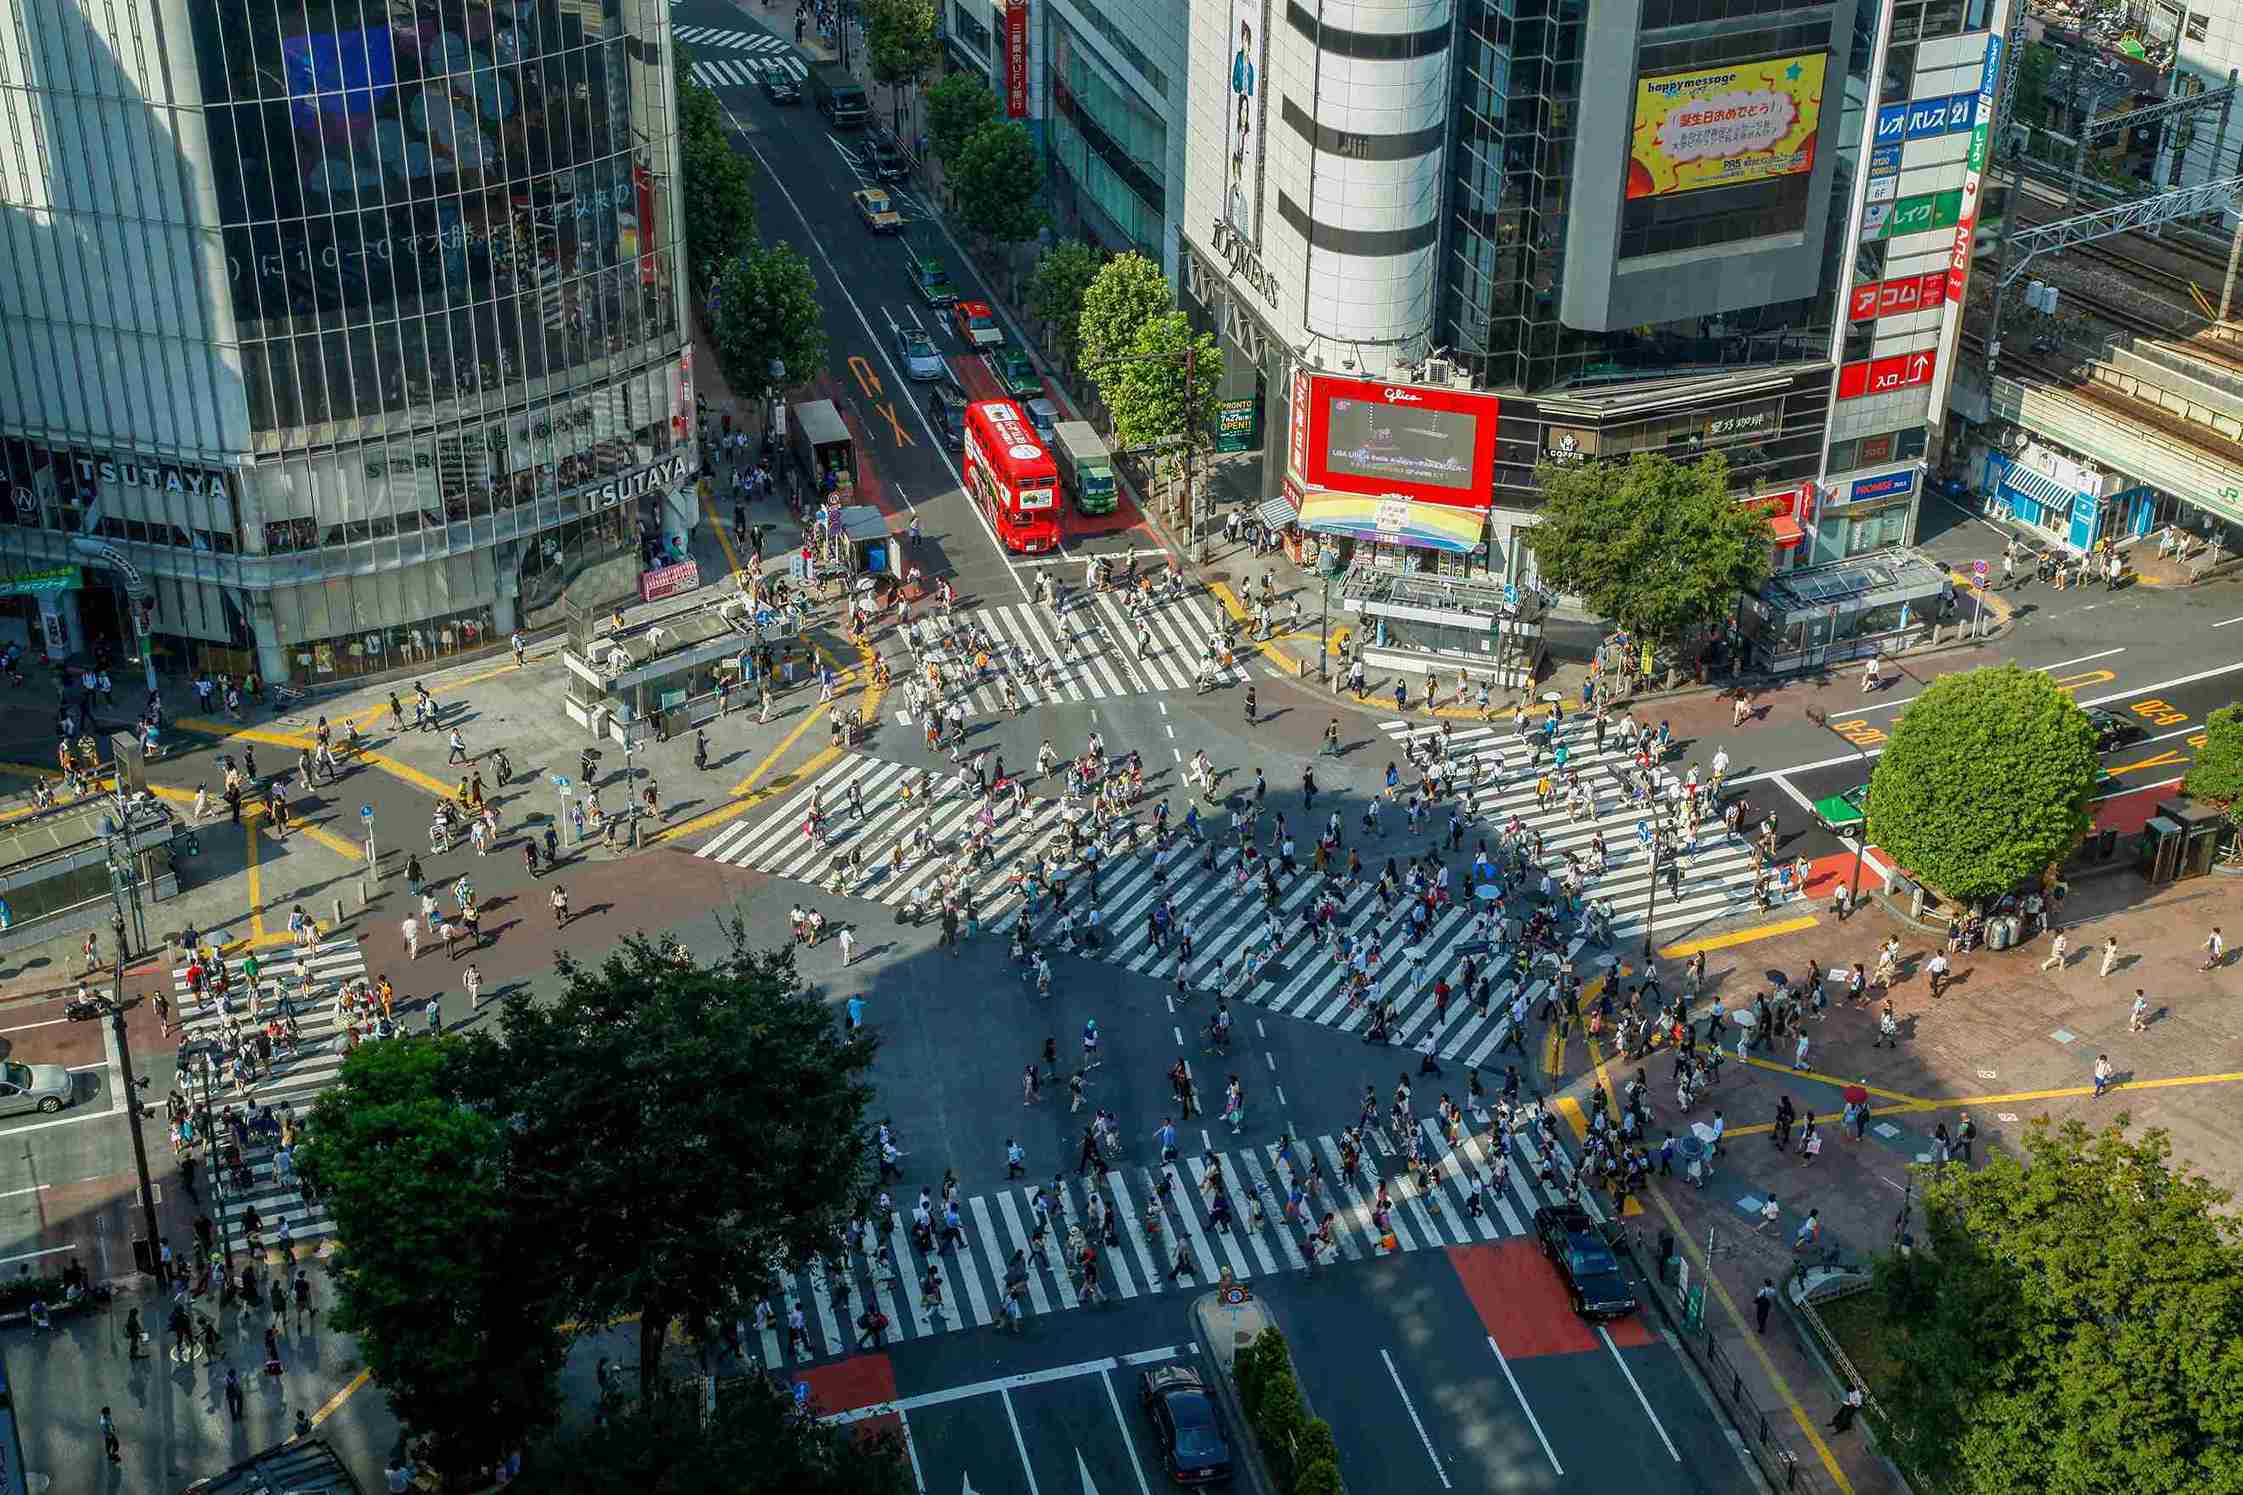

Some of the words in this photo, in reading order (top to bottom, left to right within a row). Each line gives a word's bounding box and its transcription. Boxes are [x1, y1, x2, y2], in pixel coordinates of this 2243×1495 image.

[1952, 226, 1969, 269] アコム
[1856, 285, 1917, 312] アコム
[1876, 373, 1898, 389] 入口
[76, 457, 227, 499] TSUTAYA
[585, 455, 688, 512] TSUTAYA
[2217, 486, 2240, 503] JR
